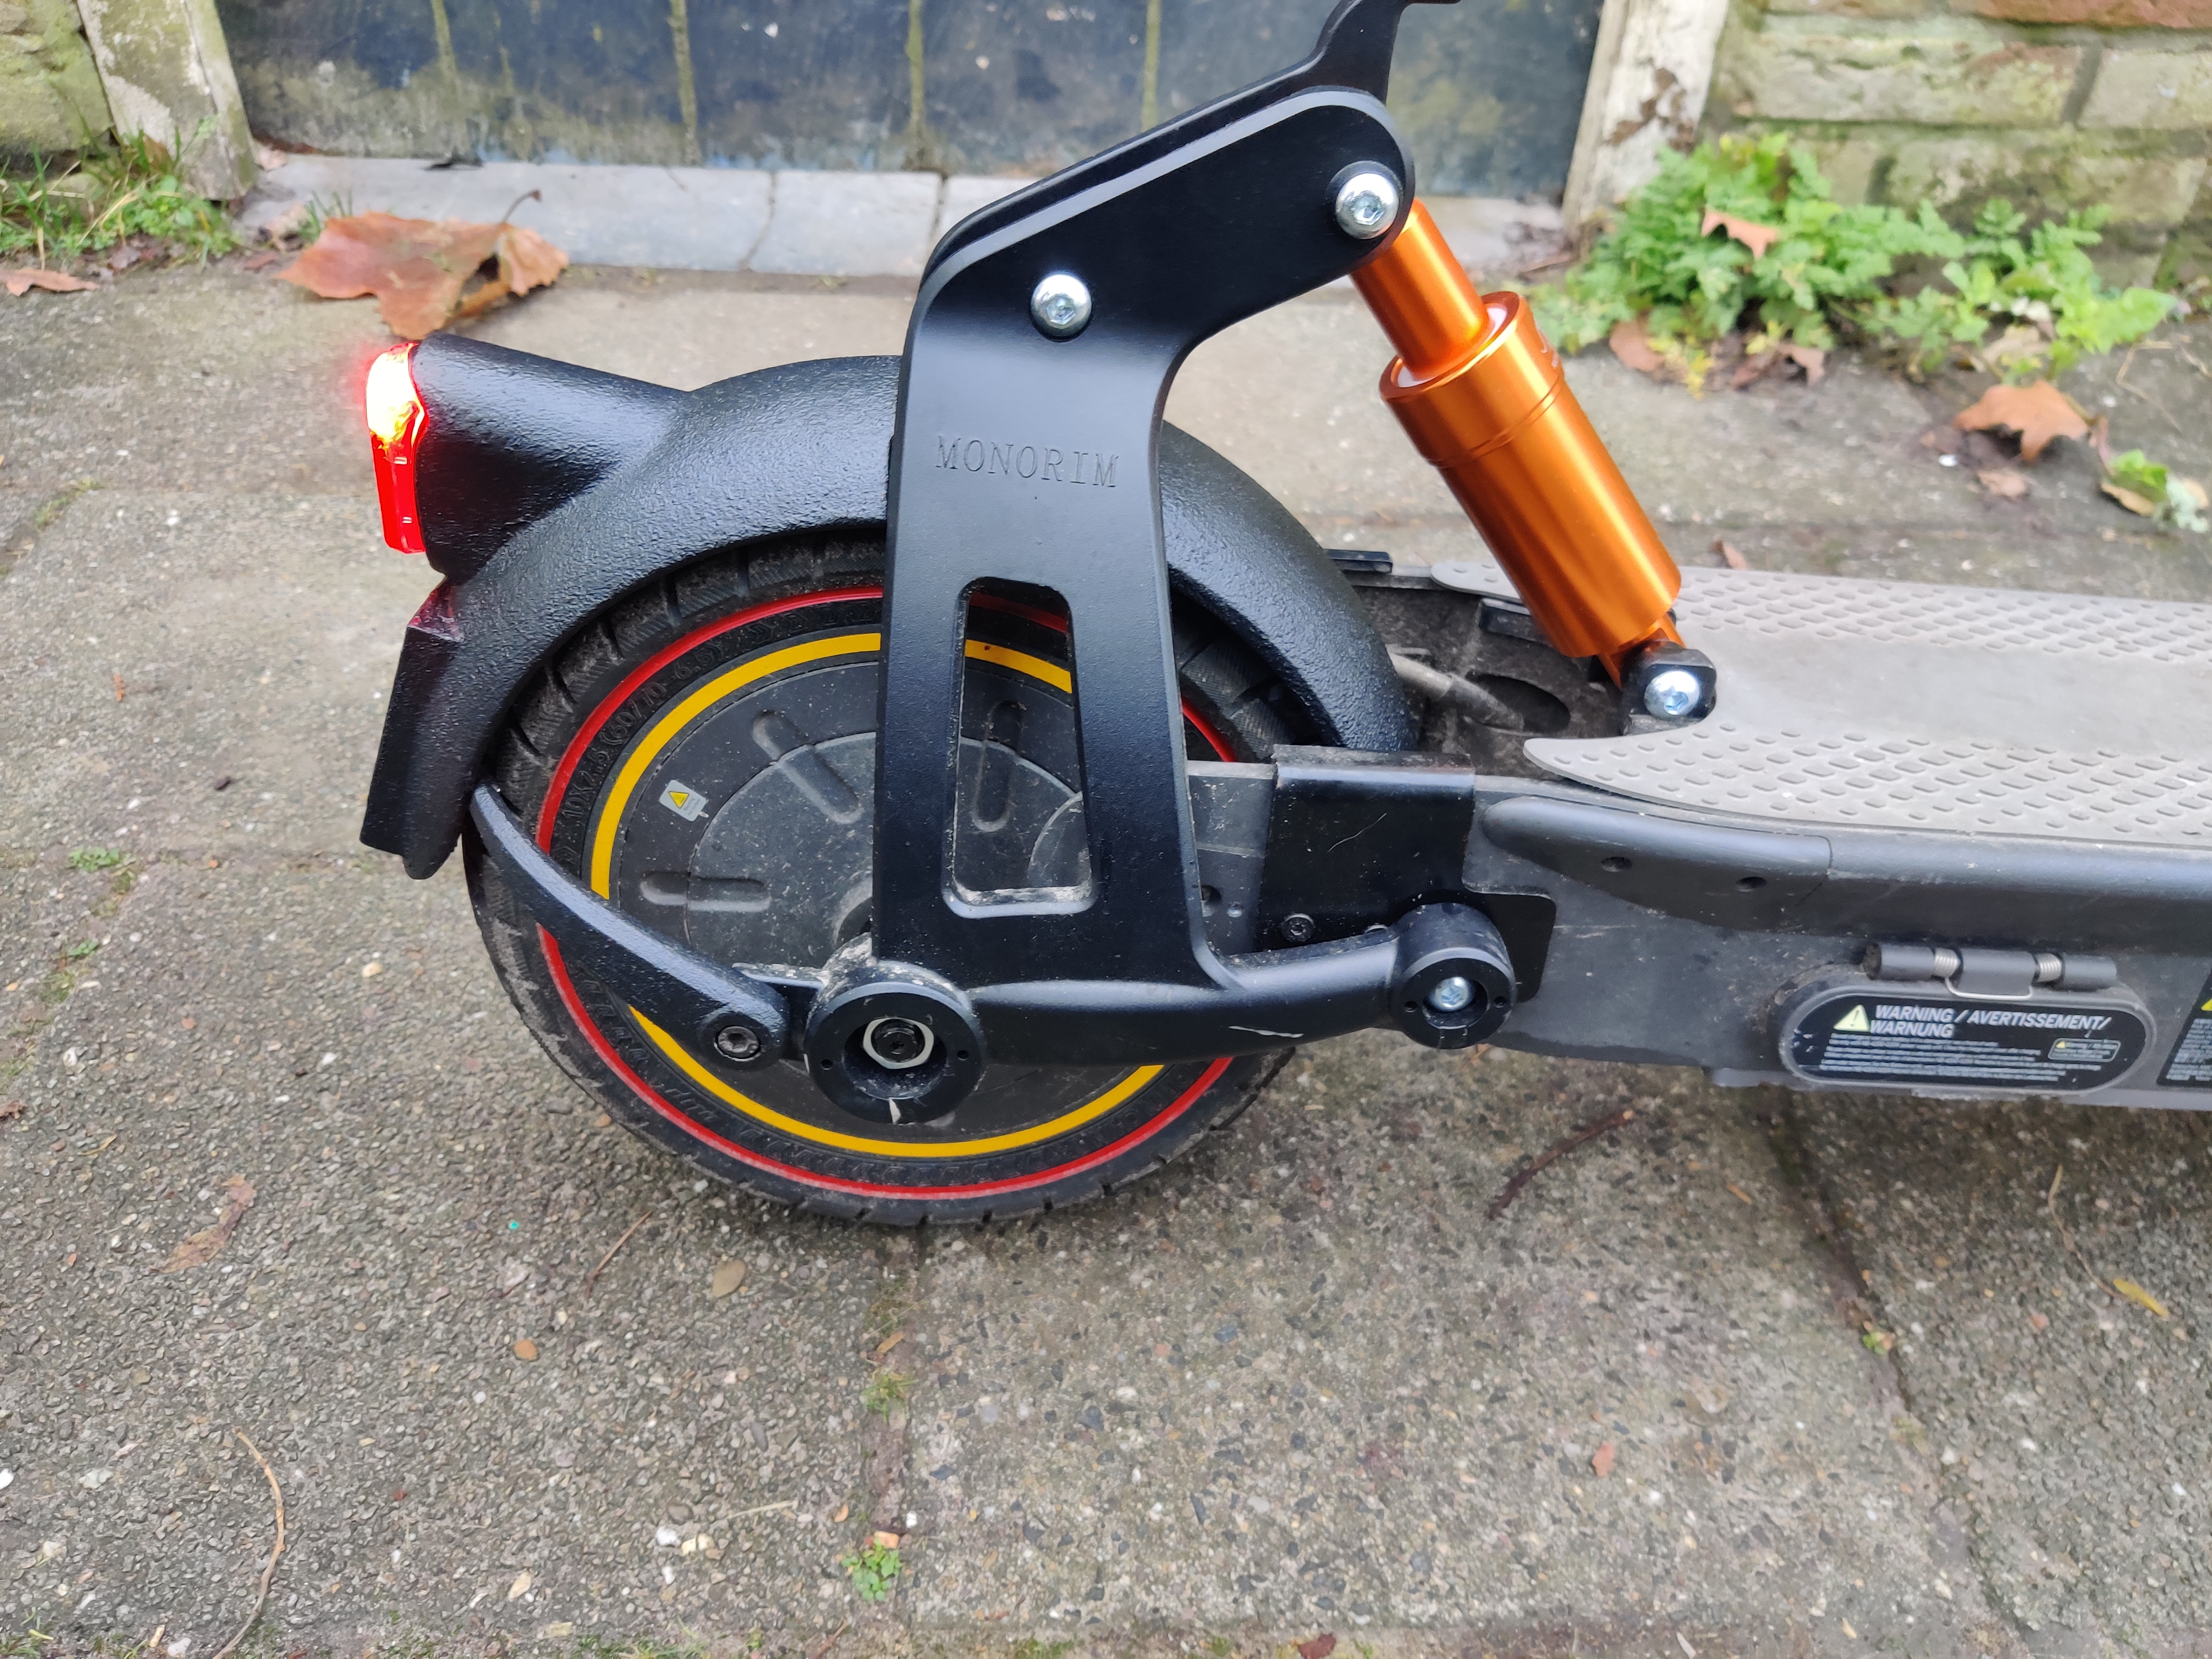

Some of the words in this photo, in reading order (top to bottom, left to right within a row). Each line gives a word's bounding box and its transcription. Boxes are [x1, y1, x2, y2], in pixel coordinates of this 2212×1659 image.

[936, 435, 1119, 488] MONORIM
[1876, 1005, 1955, 1023] WARNING
[1870, 1020, 1955, 1039] WARNUNG
